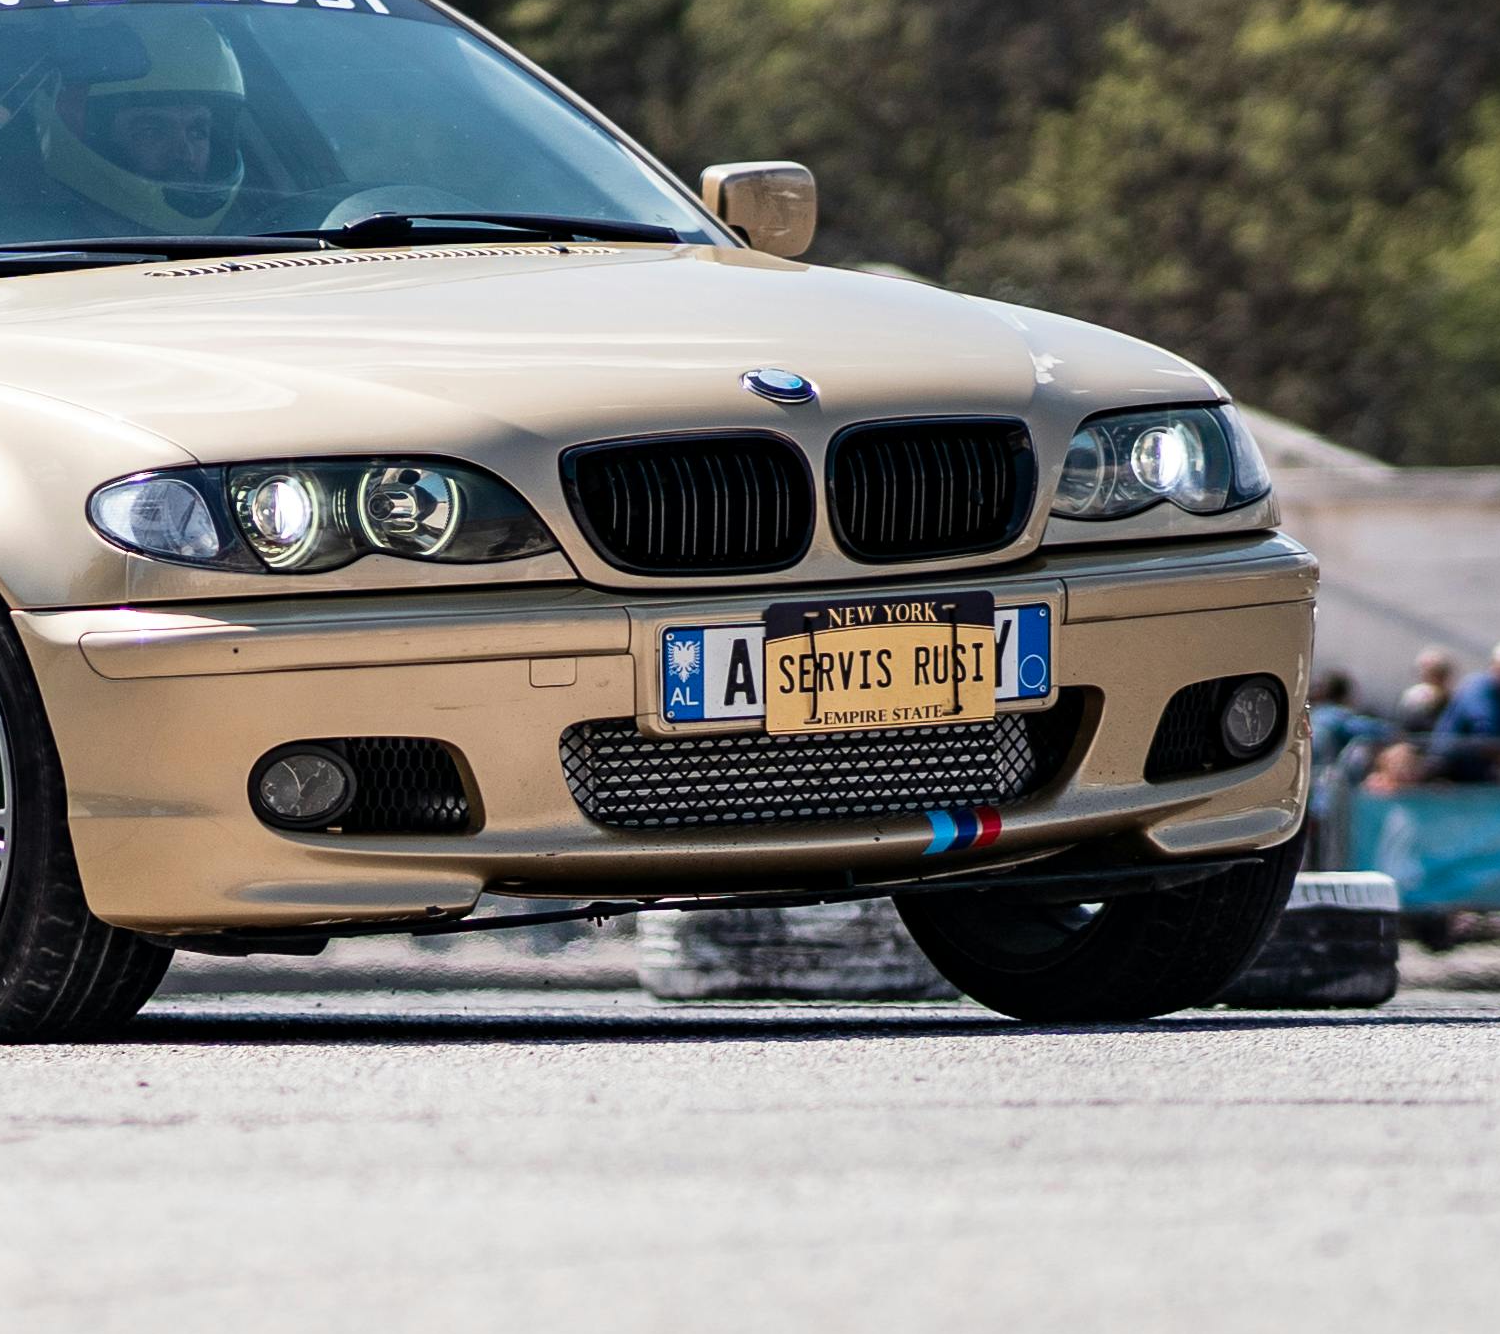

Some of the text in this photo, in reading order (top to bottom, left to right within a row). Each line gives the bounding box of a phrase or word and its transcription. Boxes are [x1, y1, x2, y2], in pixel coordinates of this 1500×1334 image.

[827, 602, 939, 628] NEW YORK
[779, 642, 985, 695] SERVIS RUSI
[670, 686, 700, 706] AL
[823, 705, 944, 725] EMPIRE STATE
